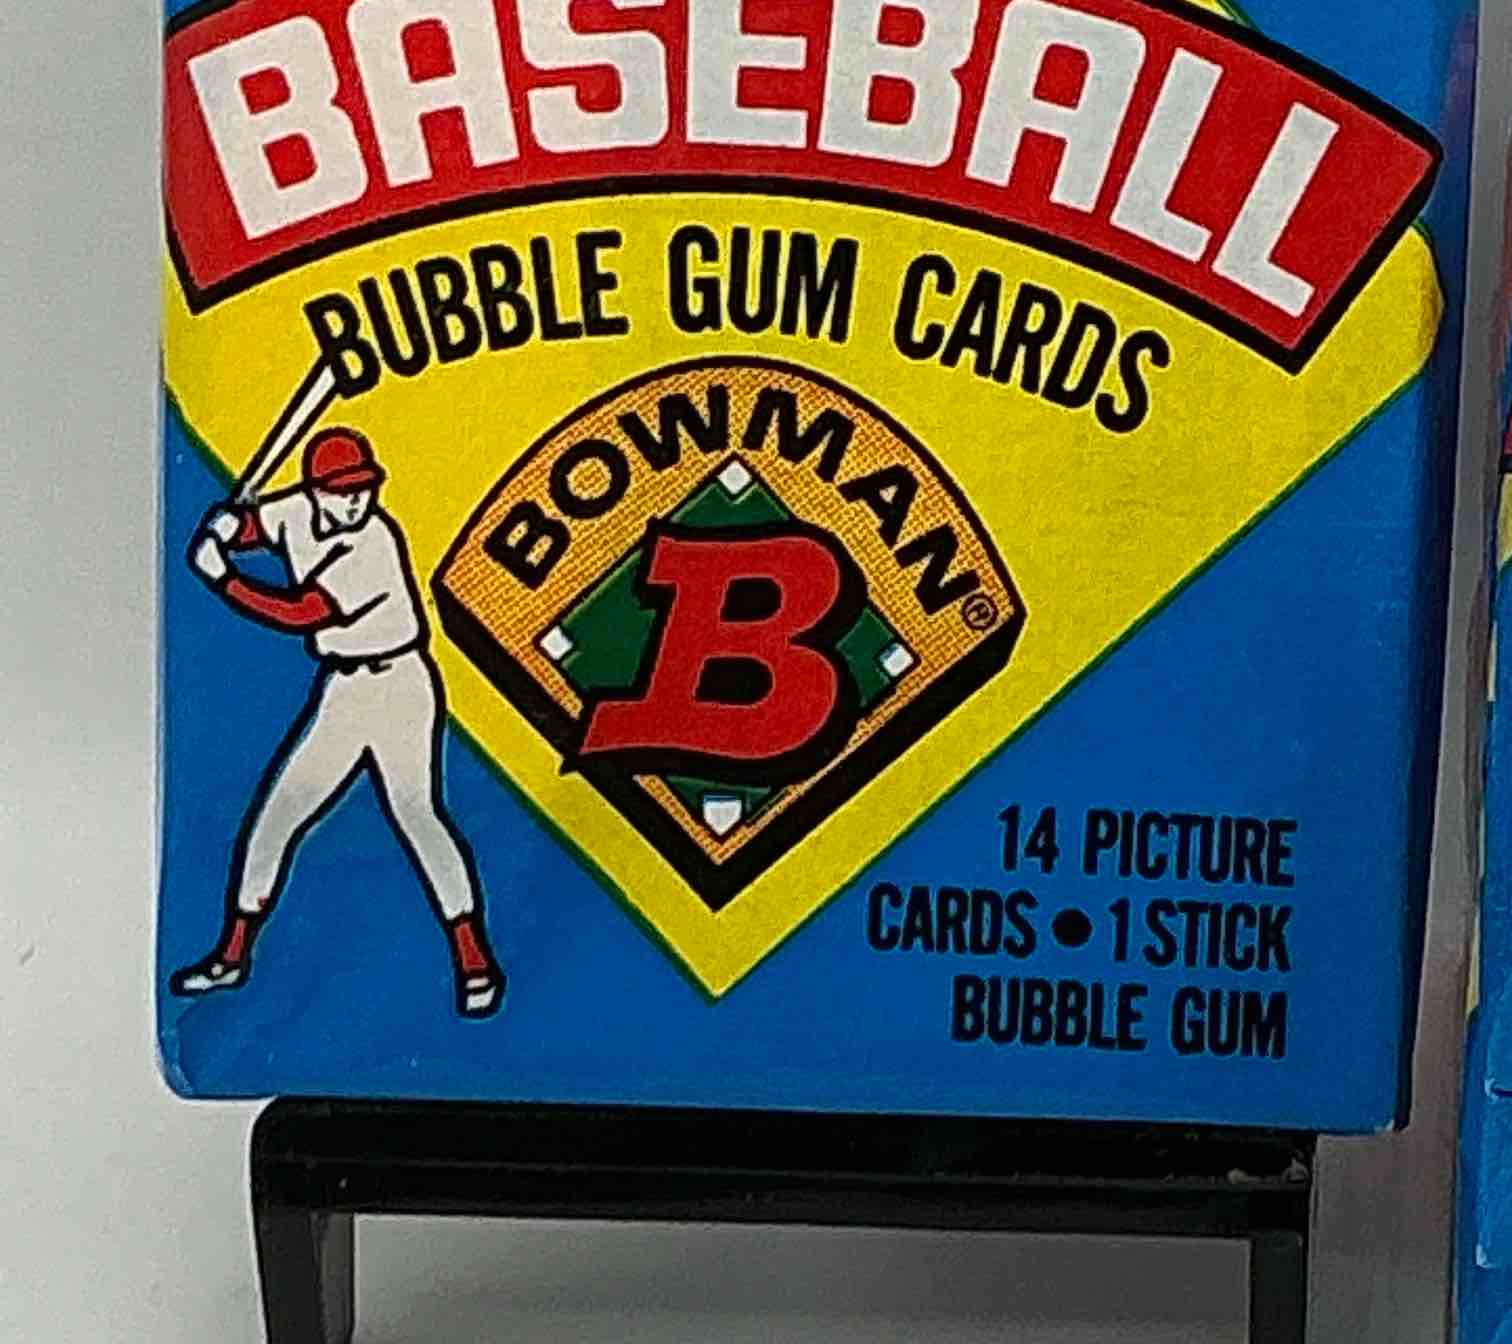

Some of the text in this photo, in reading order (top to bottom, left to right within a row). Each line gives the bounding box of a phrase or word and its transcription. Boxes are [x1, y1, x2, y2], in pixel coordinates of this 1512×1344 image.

[305, 227, 1170, 433] BUBBLE GUM CARDS
[580, 536, 839, 759] B
[999, 804, 1297, 886] 14 PICTURE
[867, 883, 1292, 972] CARDS 1 STICK
[951, 975, 1288, 1059] BUBBLE GUM
